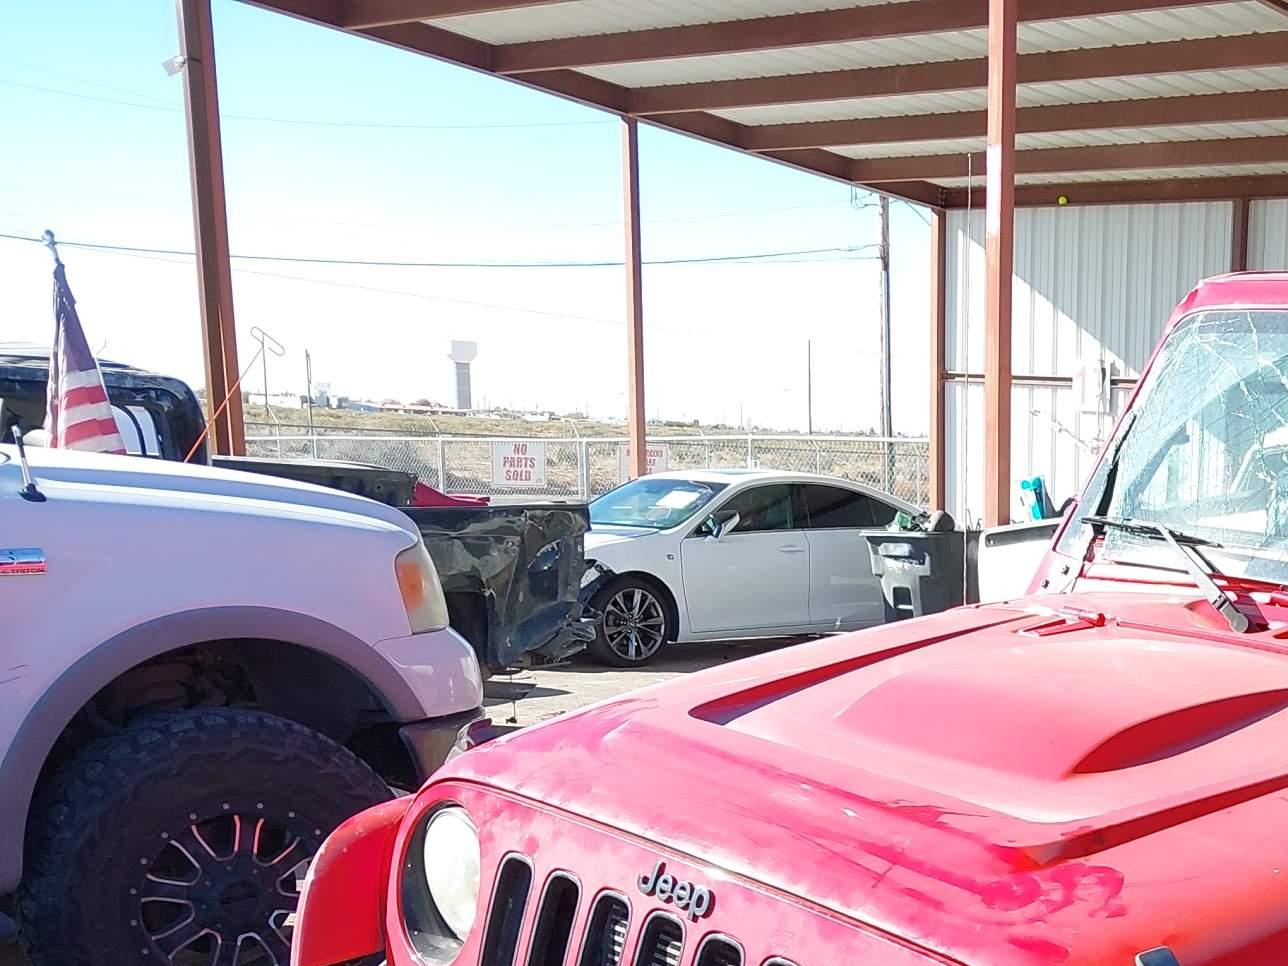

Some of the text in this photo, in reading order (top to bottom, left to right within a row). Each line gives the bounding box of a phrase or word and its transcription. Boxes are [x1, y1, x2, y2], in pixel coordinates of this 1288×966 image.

[513, 443, 528, 456] NO
[502, 456, 536, 469] PARTS
[505, 469, 532, 481] SOLD
[637, 860, 713, 922] Jeep
